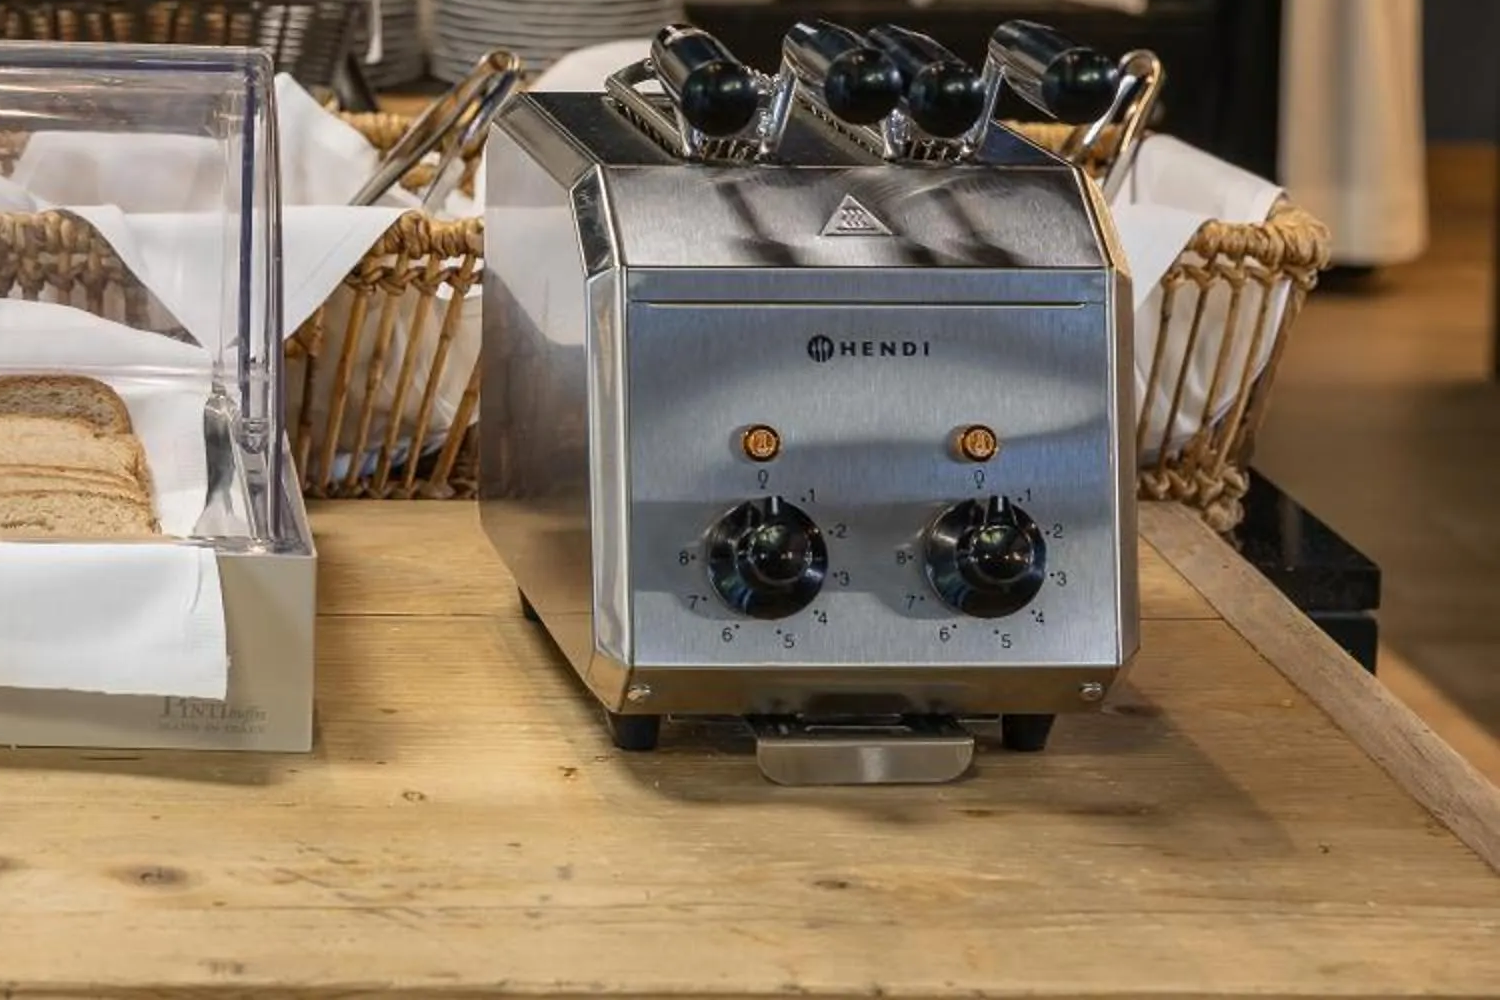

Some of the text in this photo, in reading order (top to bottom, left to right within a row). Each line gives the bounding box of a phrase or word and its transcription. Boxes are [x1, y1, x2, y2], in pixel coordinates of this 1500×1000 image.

[840, 341, 929, 357] HENDI
[757, 469, 769, 484] 0
[974, 469, 985, 484] 0
[808, 488, 816, 503] 1
[1025, 487, 1032, 502] 1
[835, 523, 848, 539] 2
[1052, 523, 1064, 539] 2
[678, 551, 690, 566] 8
[896, 551, 907, 566] 8
[839, 571, 850, 586] 3
[1056, 571, 1067, 586] 3
[688, 594, 699, 610] 7
[905, 594, 916, 610] 7
[817, 612, 828, 625] 4
[1035, 611, 1045, 625] 4
[721, 627, 733, 642] 6
[784, 634, 795, 649] 5
[939, 627, 950, 642] 6
[1001, 634, 1012, 649] 5
